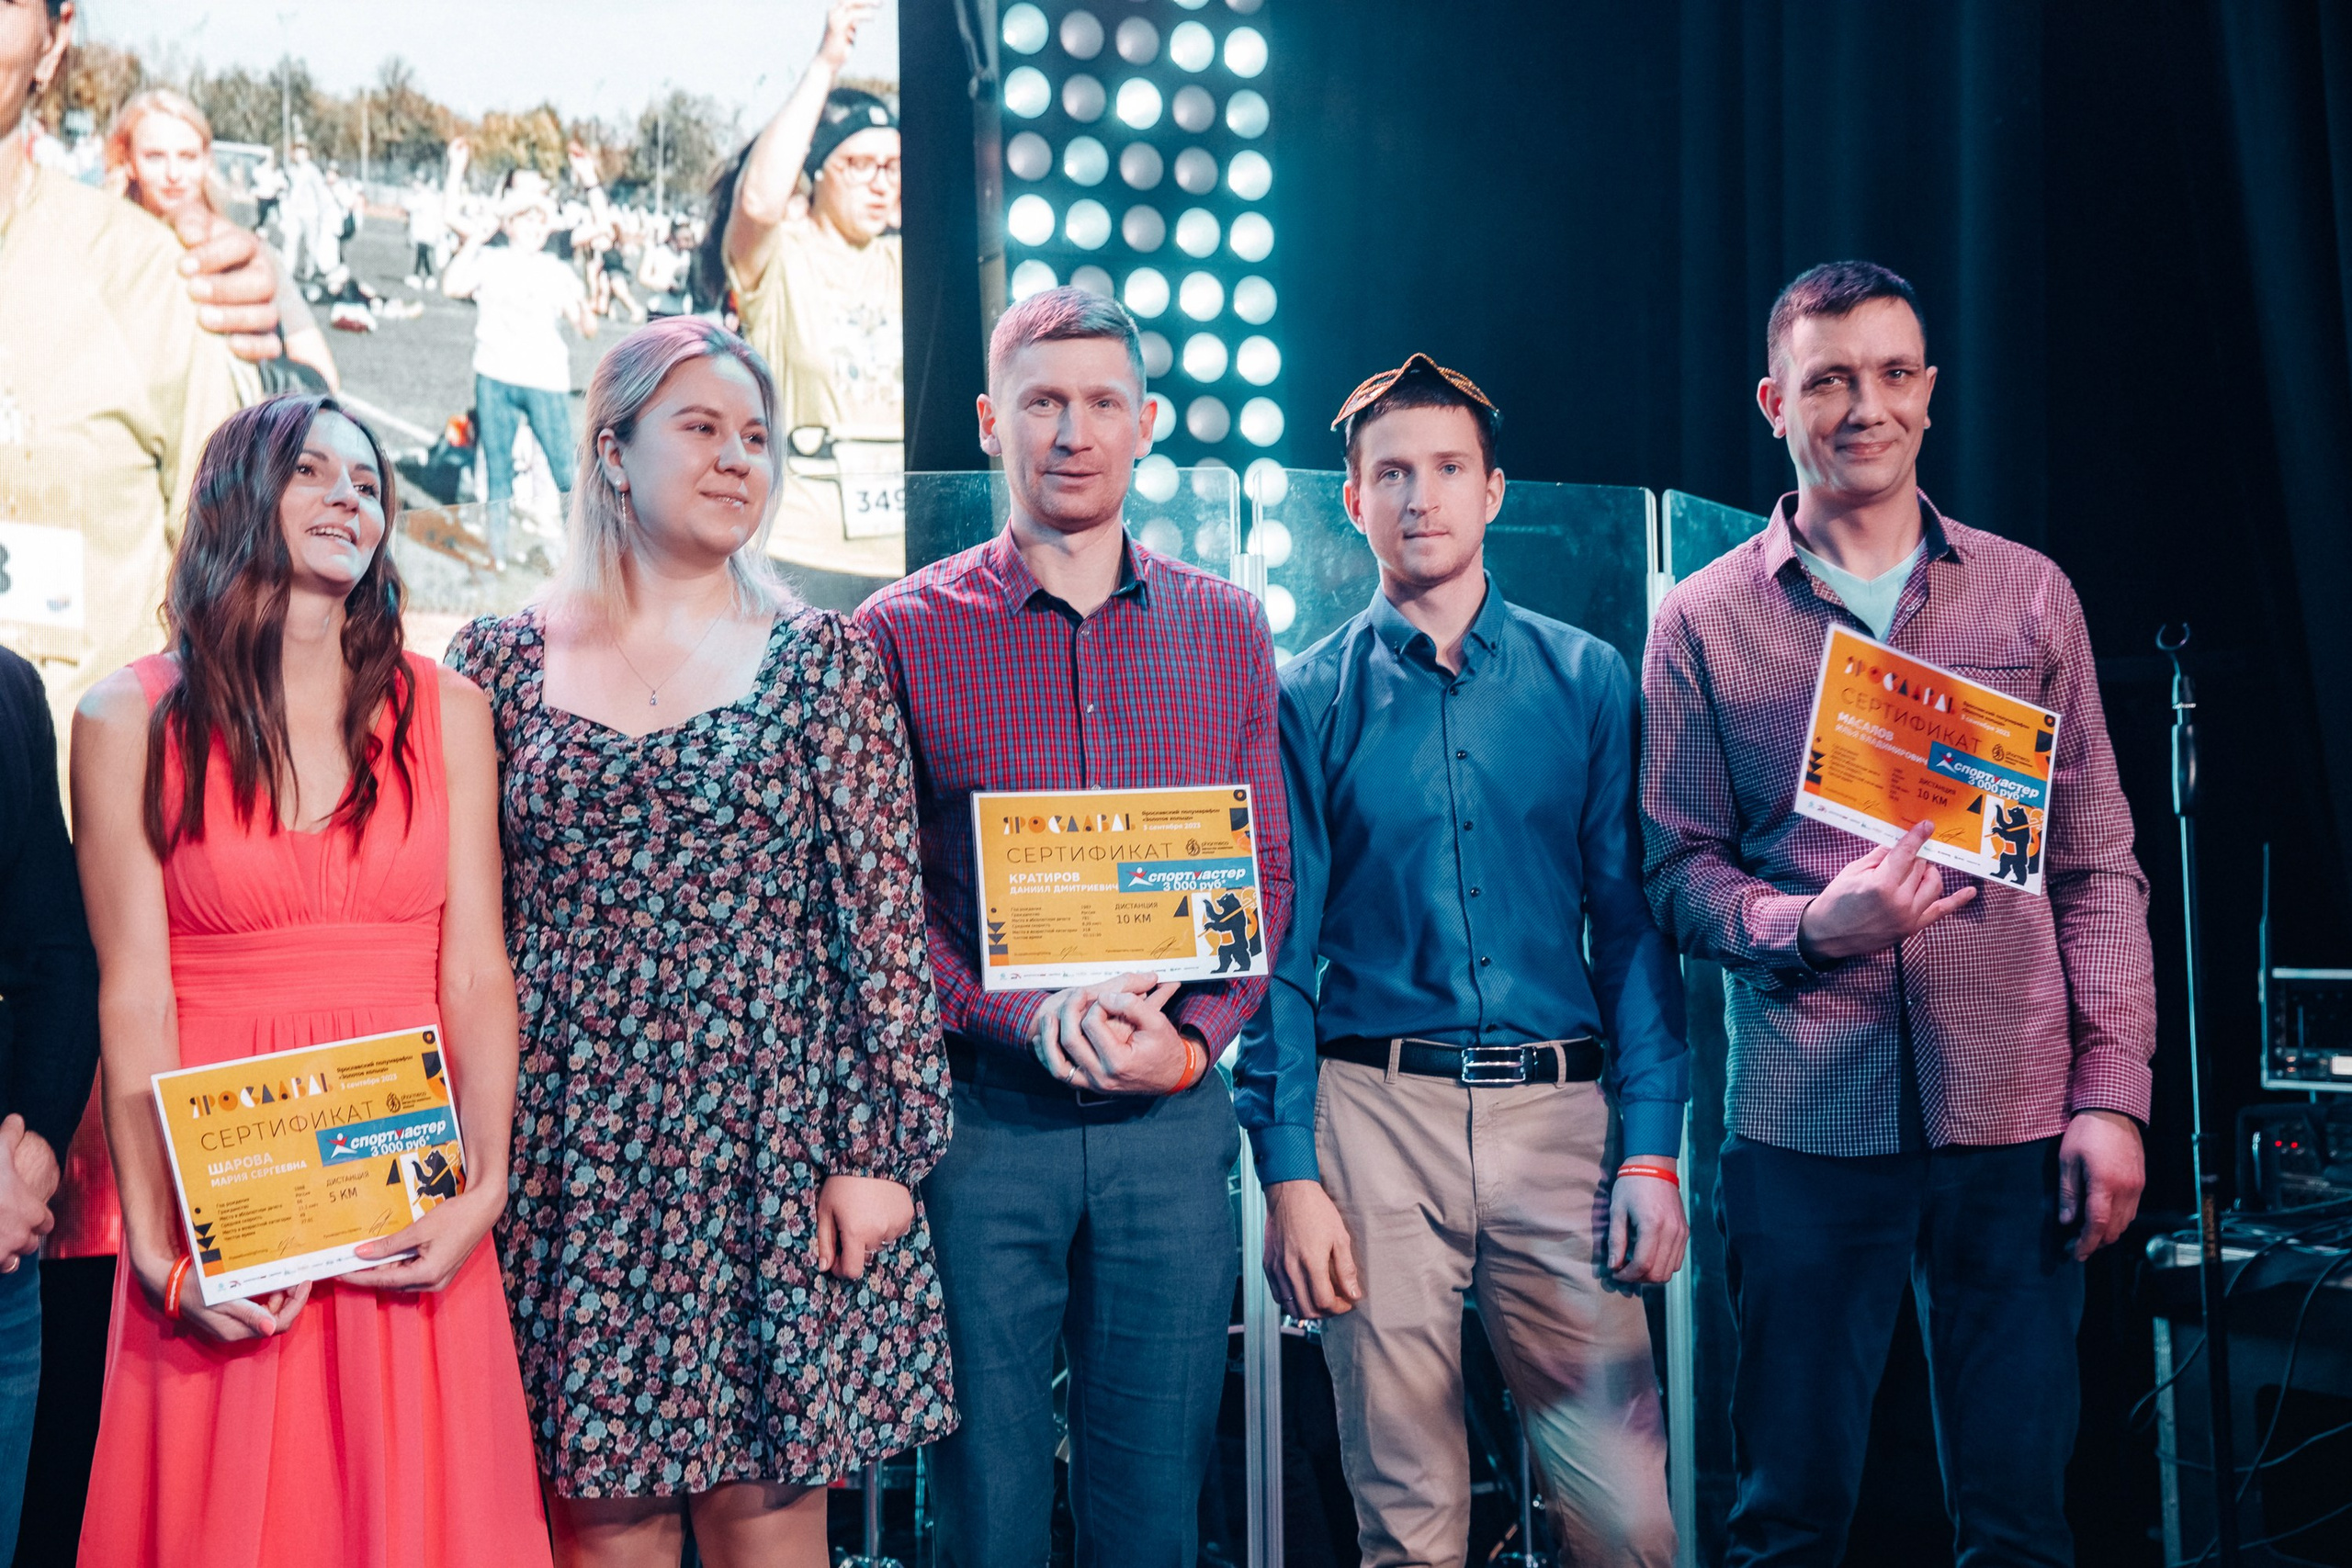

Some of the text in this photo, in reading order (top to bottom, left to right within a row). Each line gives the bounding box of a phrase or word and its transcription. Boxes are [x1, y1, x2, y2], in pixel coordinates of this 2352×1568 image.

[1840, 687, 1983, 754] СЕРТИФИКАТ
[1953, 761, 2040, 798] спортмастер
[1968, 775, 1975, 785] 3
[1976, 779, 1998, 793] 000
[1917, 788, 1929, 800] 10
[1932, 795, 1948, 807] КМ
[1007, 842, 1172, 863] СЕРТИФИКАТ
[1009, 872, 1080, 884] КРАТИРОВ
[1148, 867, 1246, 883] спортмастер
[1010, 883, 1119, 895] ДАНИИЛ ДМИТРИЕВИЧ
[1163, 883, 1170, 891] 3
[1173, 881, 1197, 891] 000
[1114, 902, 1159, 910] ДИСТАНЦИЯ
[1116, 913, 1151, 924] 10 КМ
[201, 1100, 373, 1151] СЕРТИФИКАТ
[350, 1119, 447, 1149] спортмастер
[370, 1146, 379, 1157] 3
[380, 1141, 403, 1155] 000
[208, 1152, 273, 1176] ШАРОВА
[210, 1159, 307, 1189] МАРИЯ СЕРГЕЕВНА
[326, 1170, 369, 1188] ДИСТАНЦИЯ
[329, 1187, 357, 1202] 5 КМ
